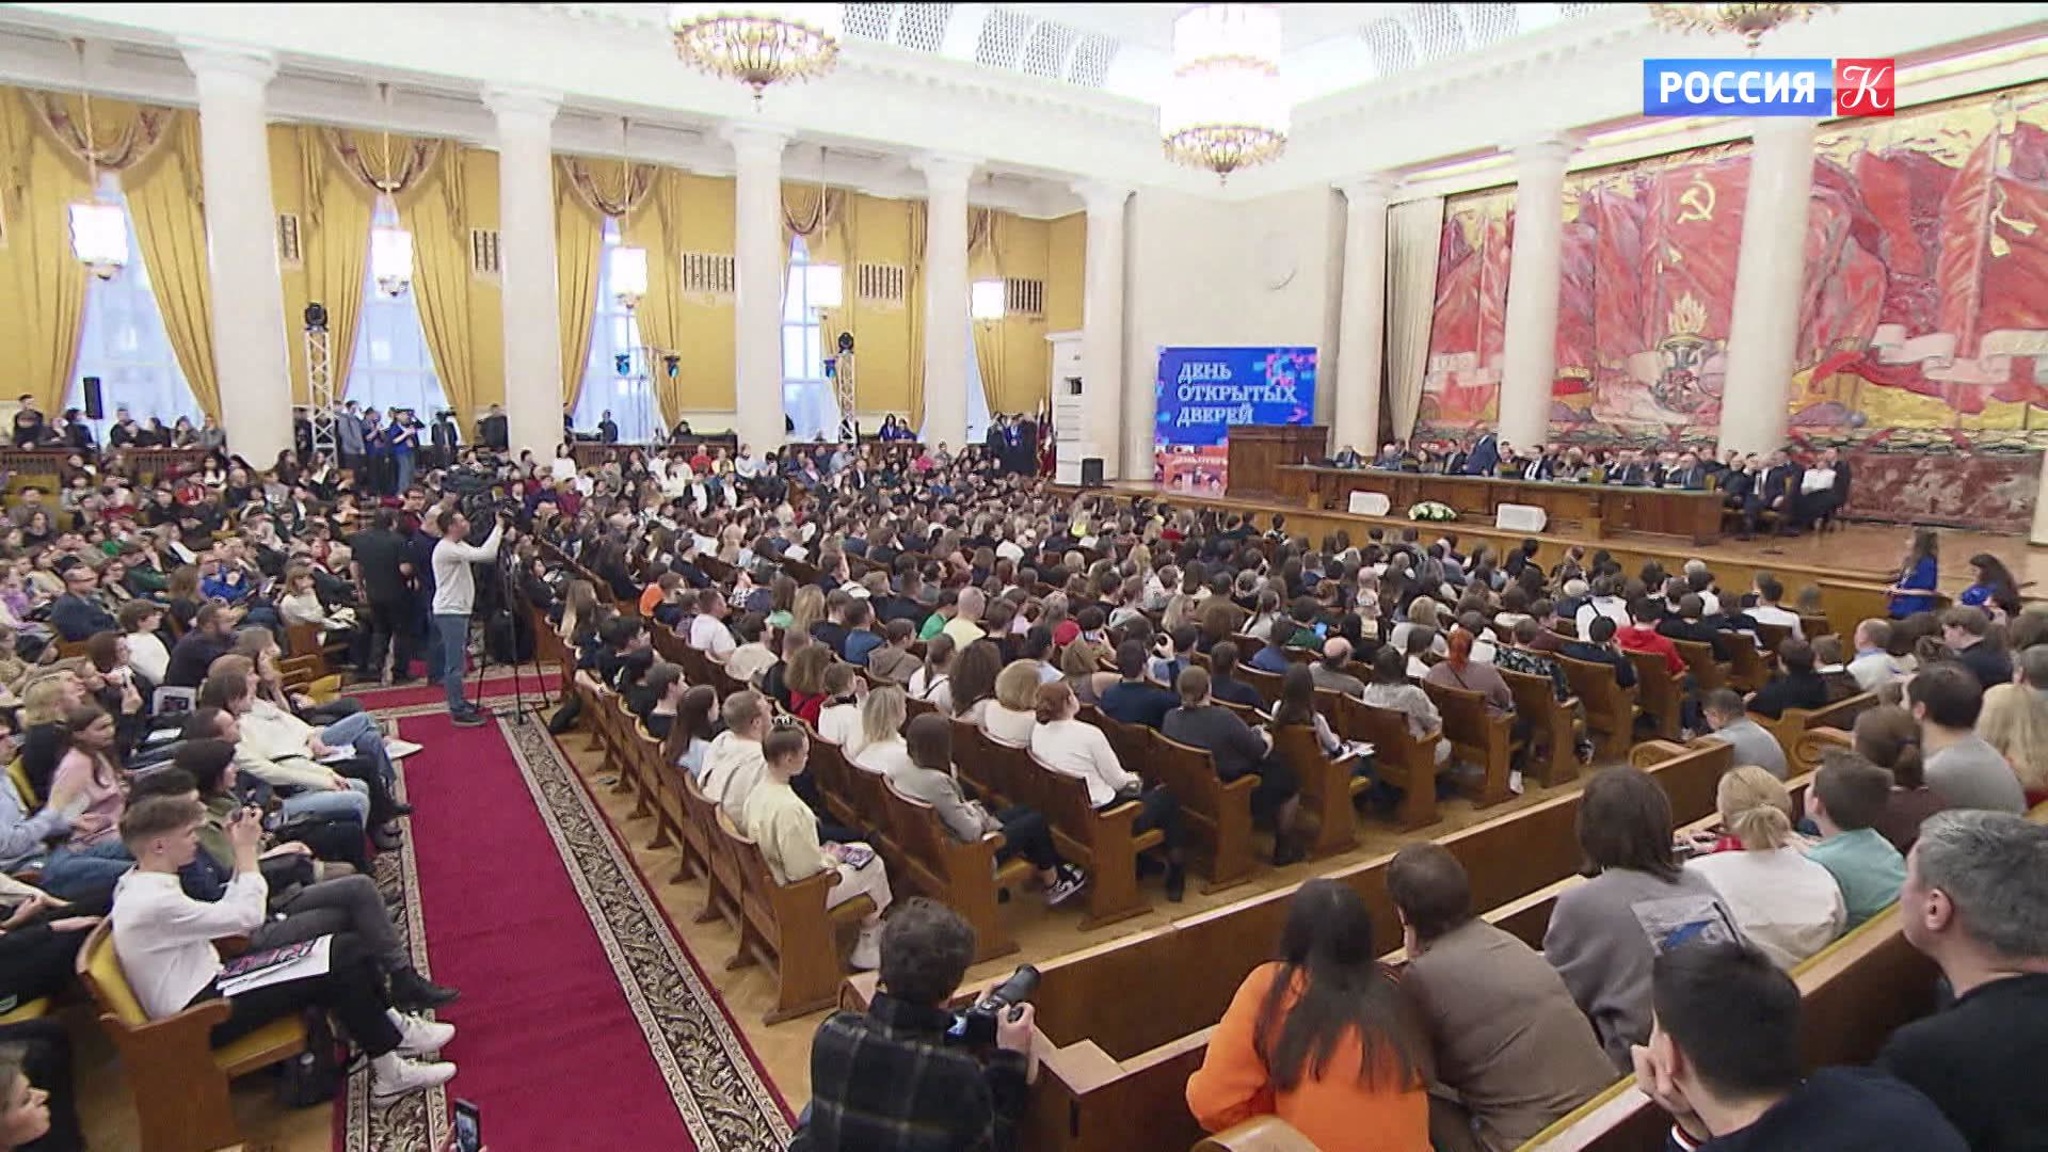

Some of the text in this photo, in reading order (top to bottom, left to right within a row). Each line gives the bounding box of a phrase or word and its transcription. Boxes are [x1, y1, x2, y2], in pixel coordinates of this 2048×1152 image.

[1178, 362, 1232, 384] ДЕНЬ
[1177, 385, 1297, 403] ОТКРЫТЫХ
[1176, 403, 1253, 427] ДВЕРЕЙ
